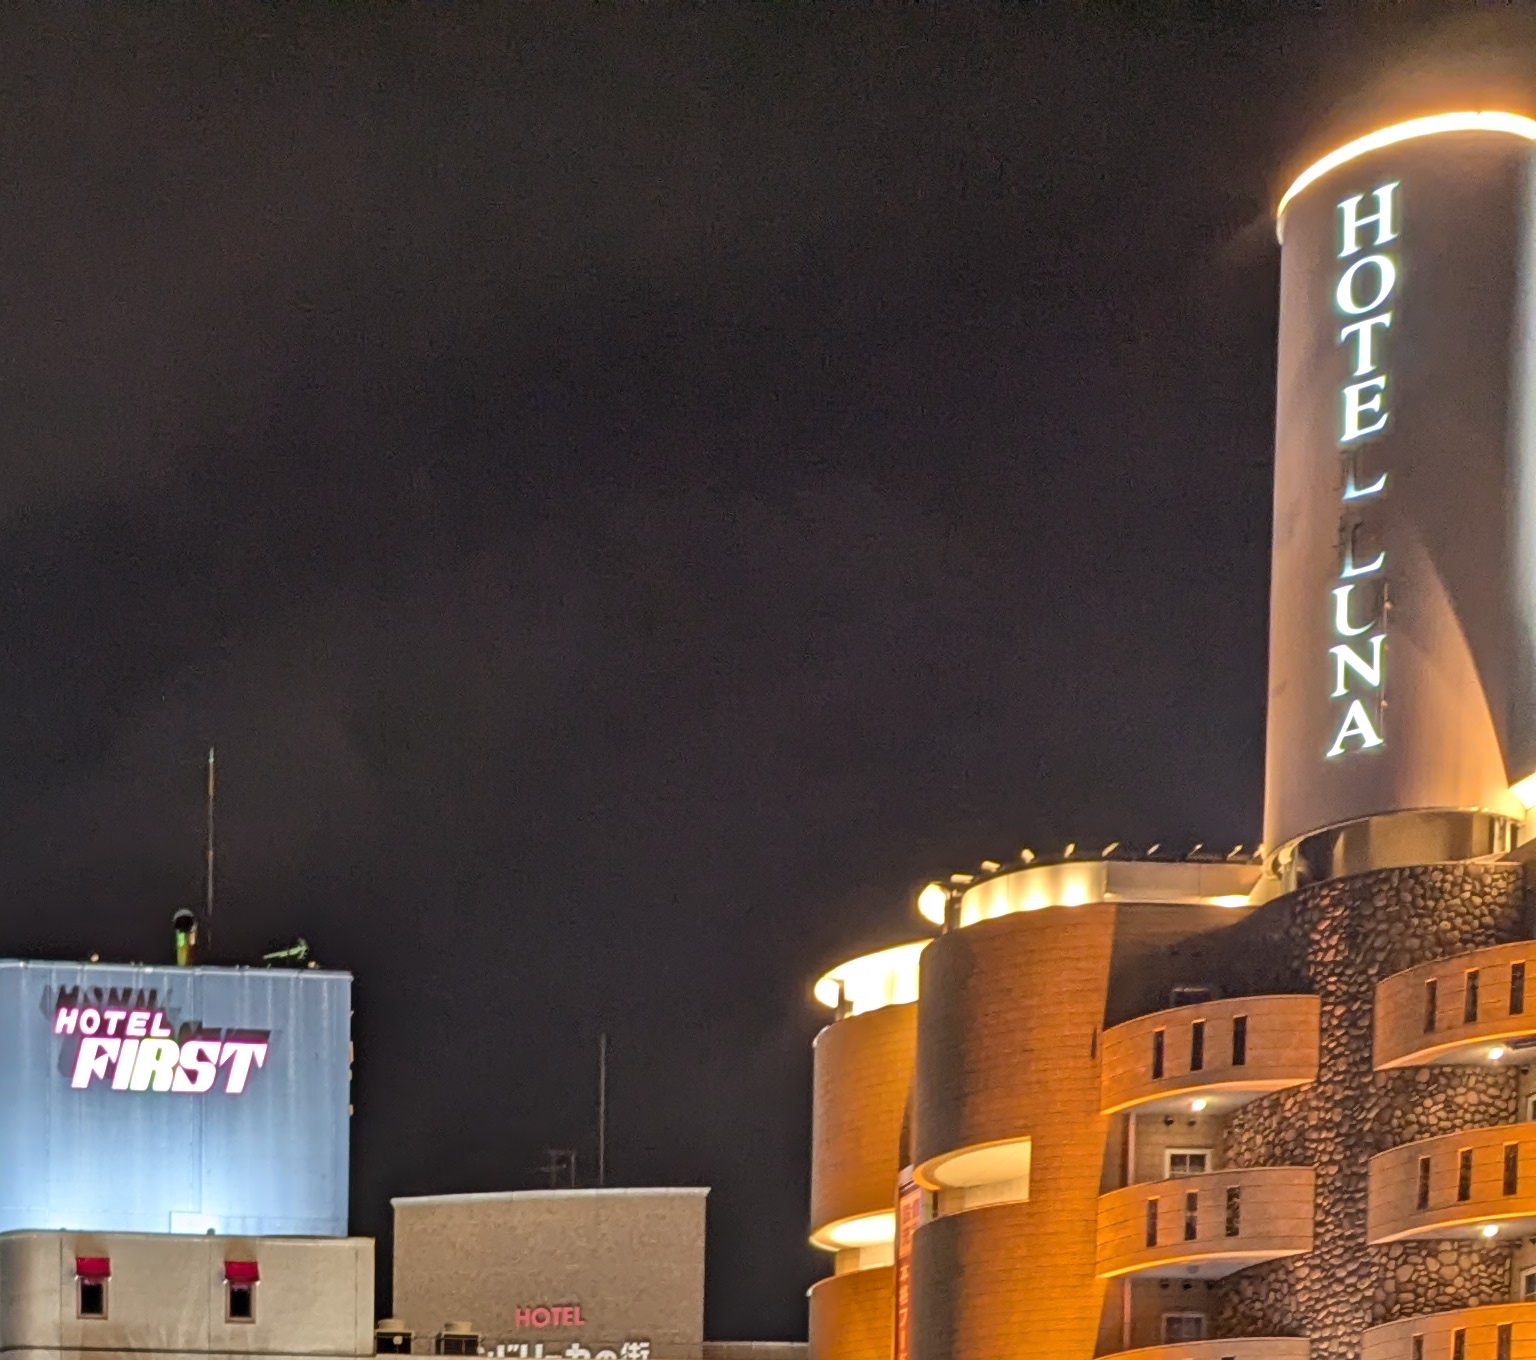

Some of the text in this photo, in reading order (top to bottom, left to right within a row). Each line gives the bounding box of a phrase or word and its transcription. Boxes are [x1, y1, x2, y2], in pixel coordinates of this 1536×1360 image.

[1325, 181, 1401, 758] HOTEL LUNA
[54, 1007, 172, 1037] HOTEL
[71, 1037, 268, 1093] FIRST
[514, 1306, 585, 1329] HOTEL
